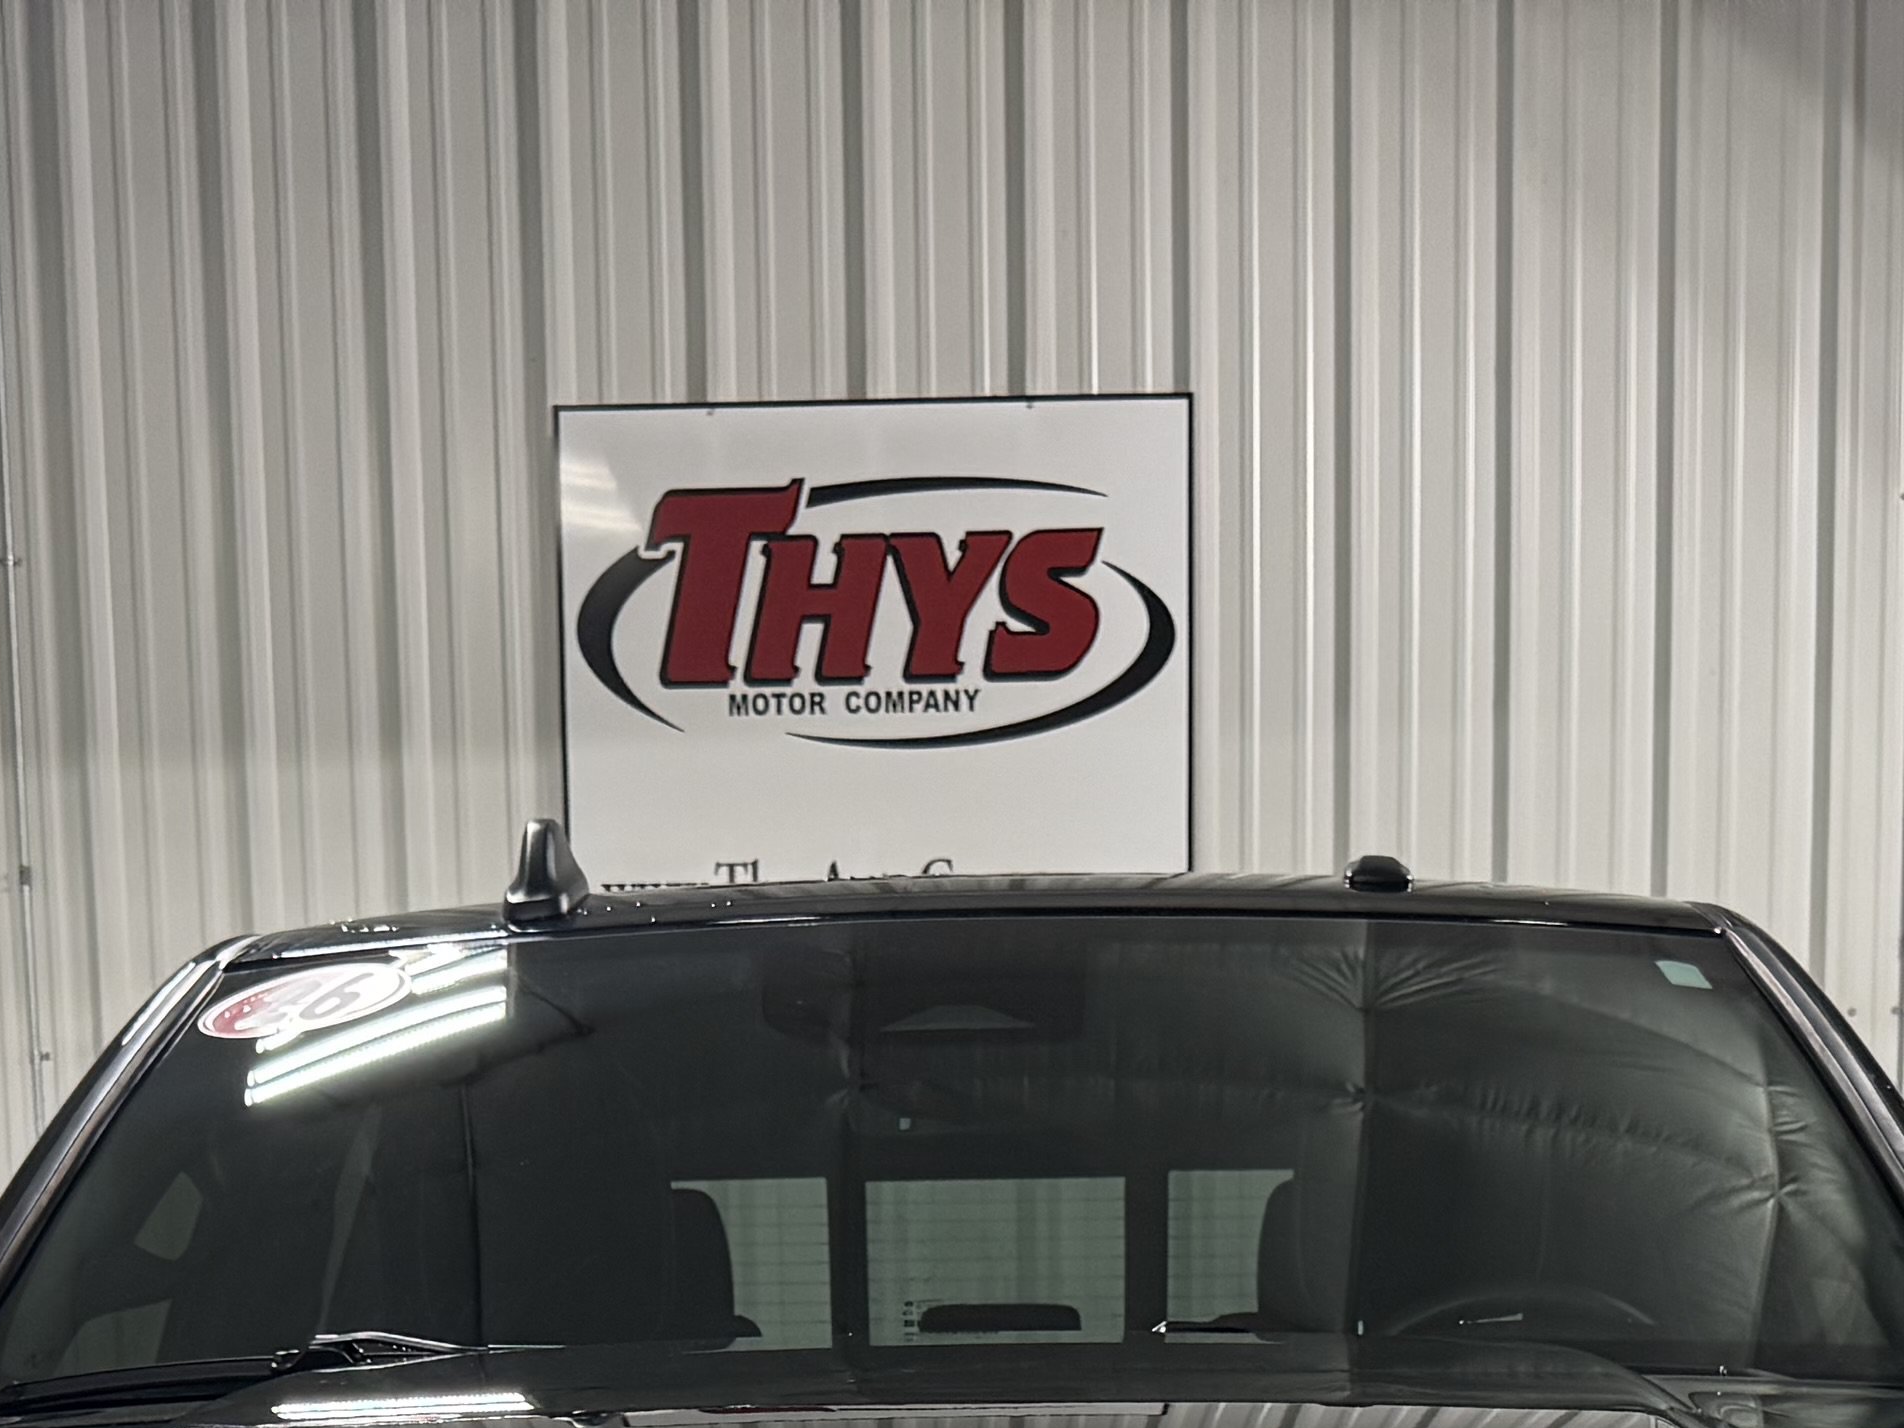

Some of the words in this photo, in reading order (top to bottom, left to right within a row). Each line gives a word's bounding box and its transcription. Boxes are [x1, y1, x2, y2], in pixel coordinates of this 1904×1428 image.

[645, 478, 1104, 690] THYS
[728, 693, 827, 717] MOTOR
[845, 689, 981, 715] COMPANY
